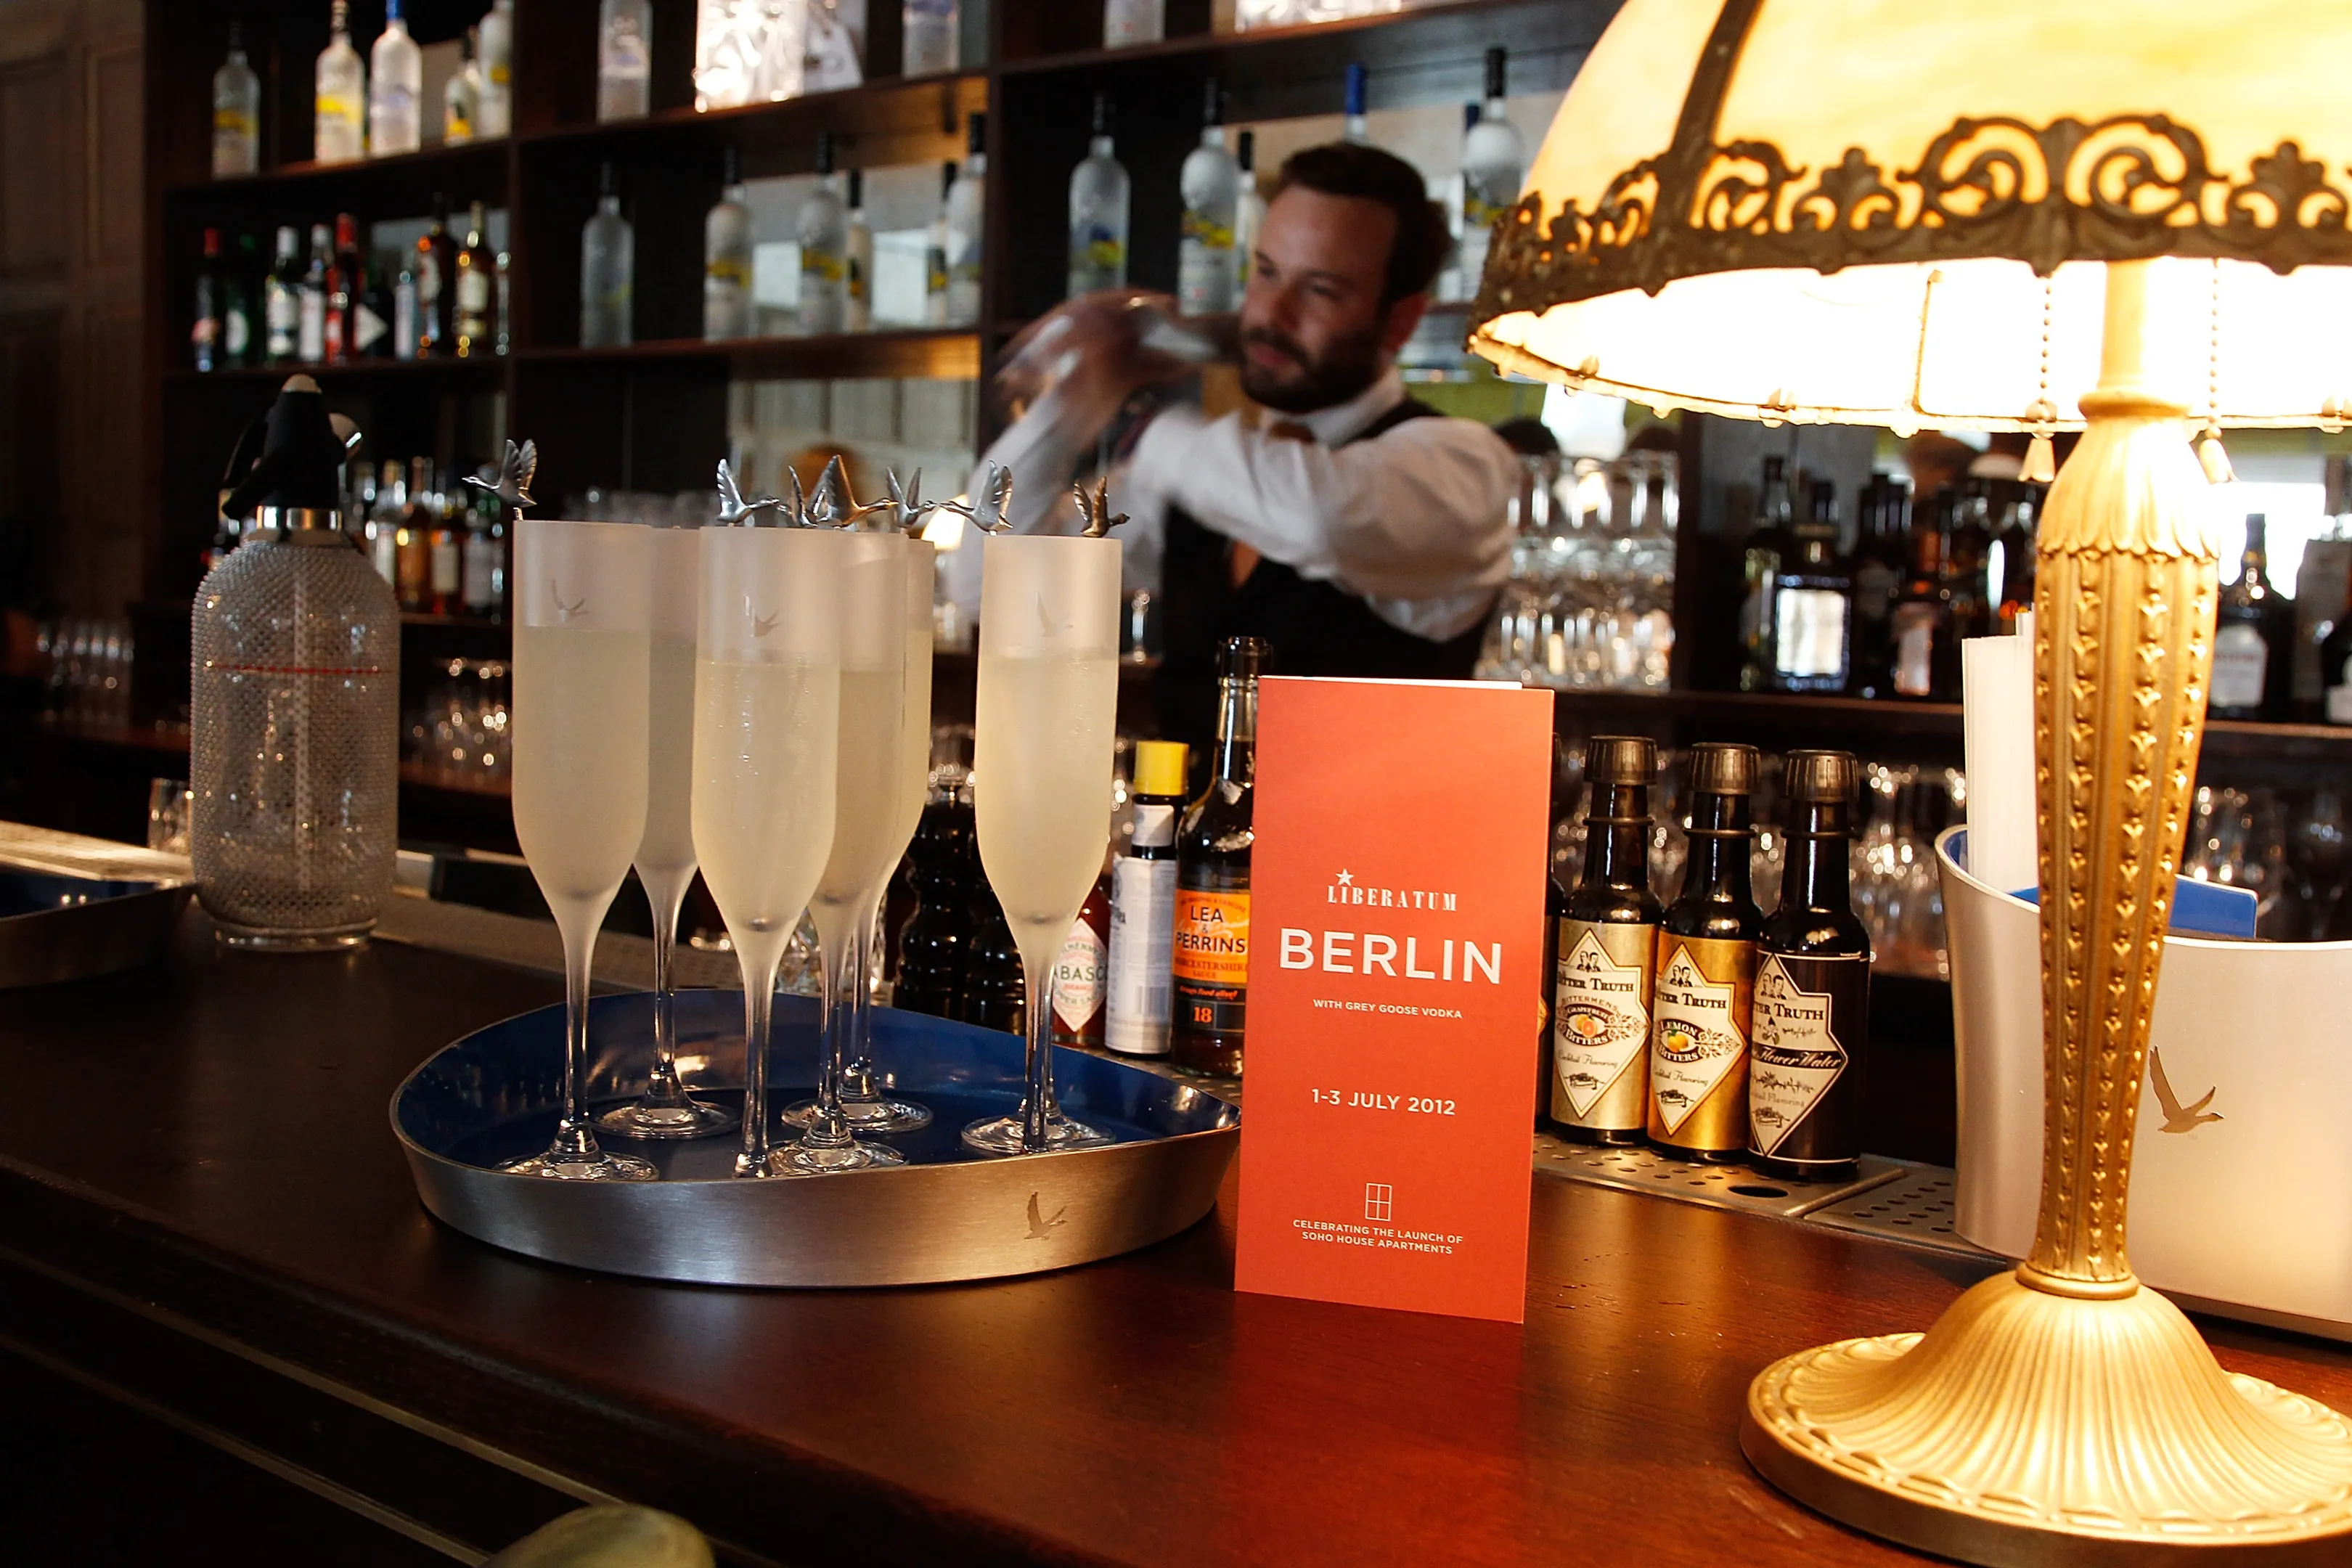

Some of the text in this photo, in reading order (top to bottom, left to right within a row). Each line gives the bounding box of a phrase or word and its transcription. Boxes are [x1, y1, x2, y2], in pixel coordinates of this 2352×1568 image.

[1327, 885, 1457, 912] LIBERATUM
[1191, 907, 1223, 923] LEA
[1177, 932, 1246, 953] PERRINS
[1279, 928, 1502, 984] BERLIN
[1054, 965, 1106, 981] BASC
[1590, 978, 1634, 992] TRUTH
[1312, 999, 1463, 1018] WITH GREY GOOSE VODKA
[1682, 992, 1727, 1009] TRUTH
[1193, 1006, 1213, 1023] 18
[1755, 1001, 1824, 1021] TER TRUTH
[1566, 1029, 1609, 1045] BITTERS
[1660, 1021, 1698, 1036] LEMON
[1312, 1088, 1455, 1116] 1-3 JULY 2012
[1293, 1219, 1463, 1244] CELEBRATING THE LAUNCH OF
[1302, 1231, 1453, 1254] SOHO HOUSE APARTMENTS
